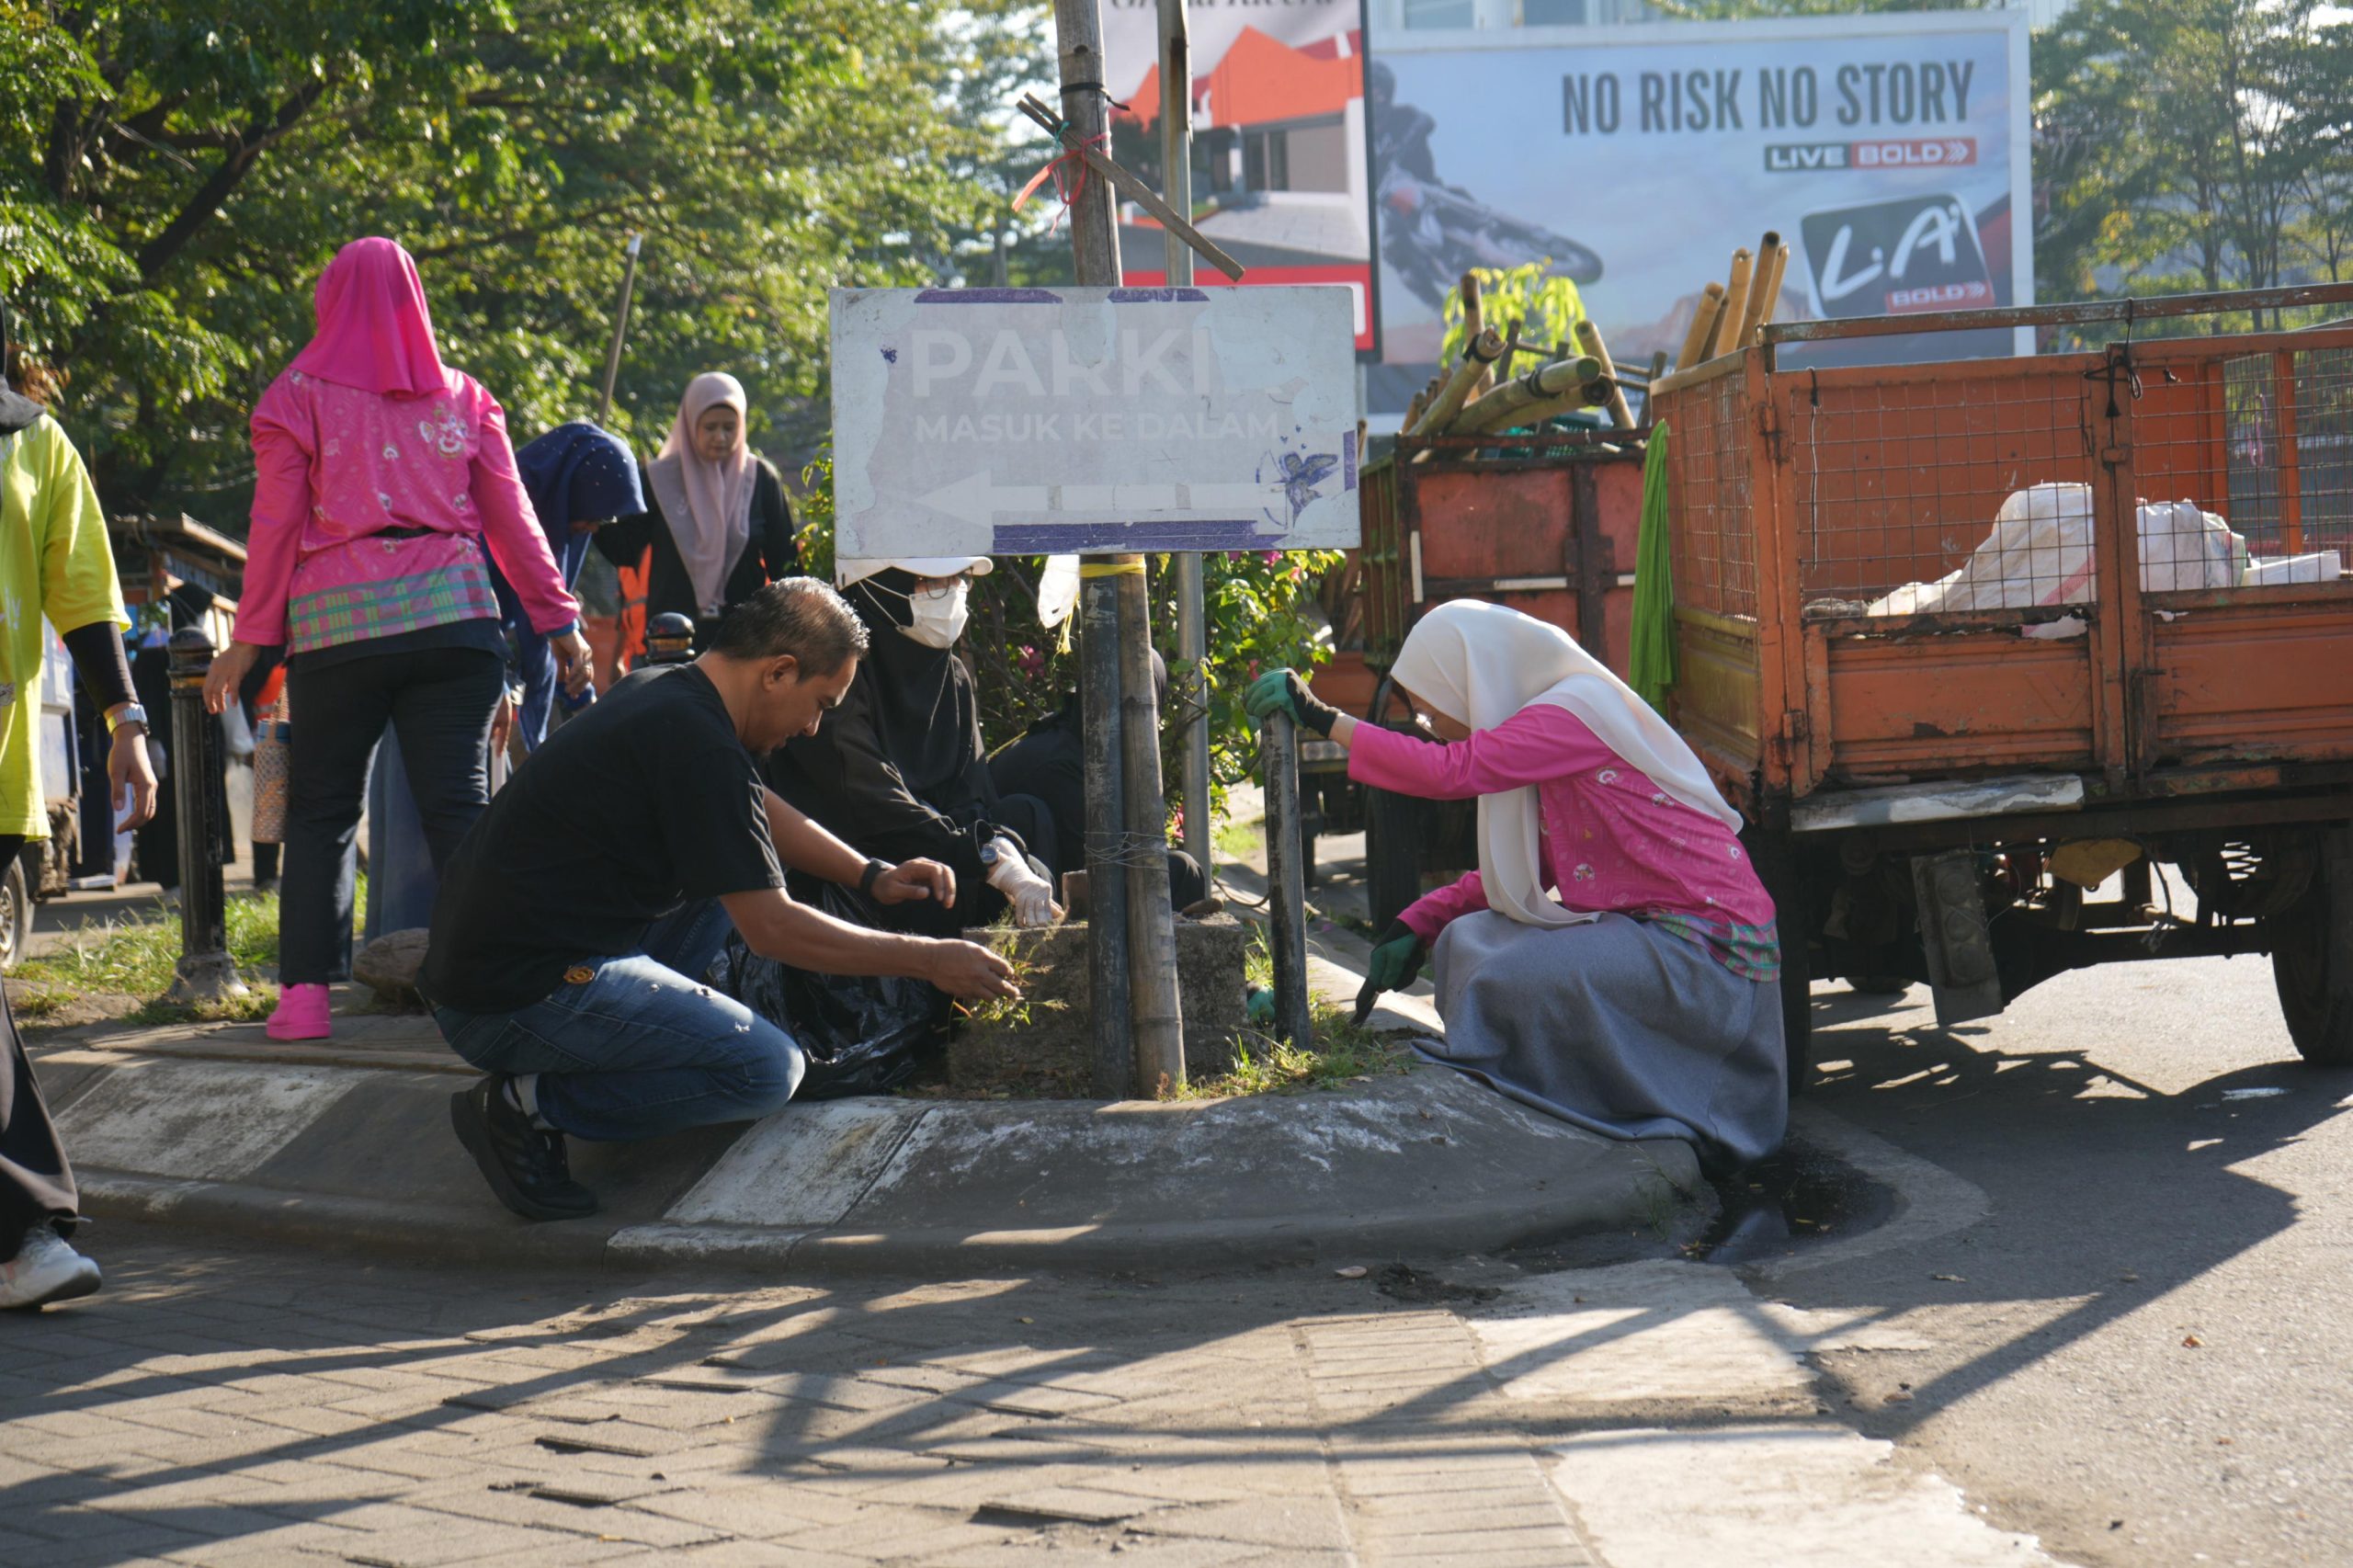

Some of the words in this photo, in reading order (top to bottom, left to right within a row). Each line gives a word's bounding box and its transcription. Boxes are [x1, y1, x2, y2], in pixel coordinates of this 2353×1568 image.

[1563, 71, 1620, 135] NO
[1640, 68, 1743, 132] RISK
[1759, 66, 1817, 129] NO
[1836, 61, 1973, 126] STORY
[1770, 145, 1845, 169] LIVE
[1858, 142, 1944, 165] BOLD
[1892, 284, 1966, 308] BOLD
[911, 328, 1284, 397] PARKI
[915, 414, 1061, 443] MASUK
[1074, 413, 1125, 441] KE
[1137, 412, 1279, 440] DALAM
